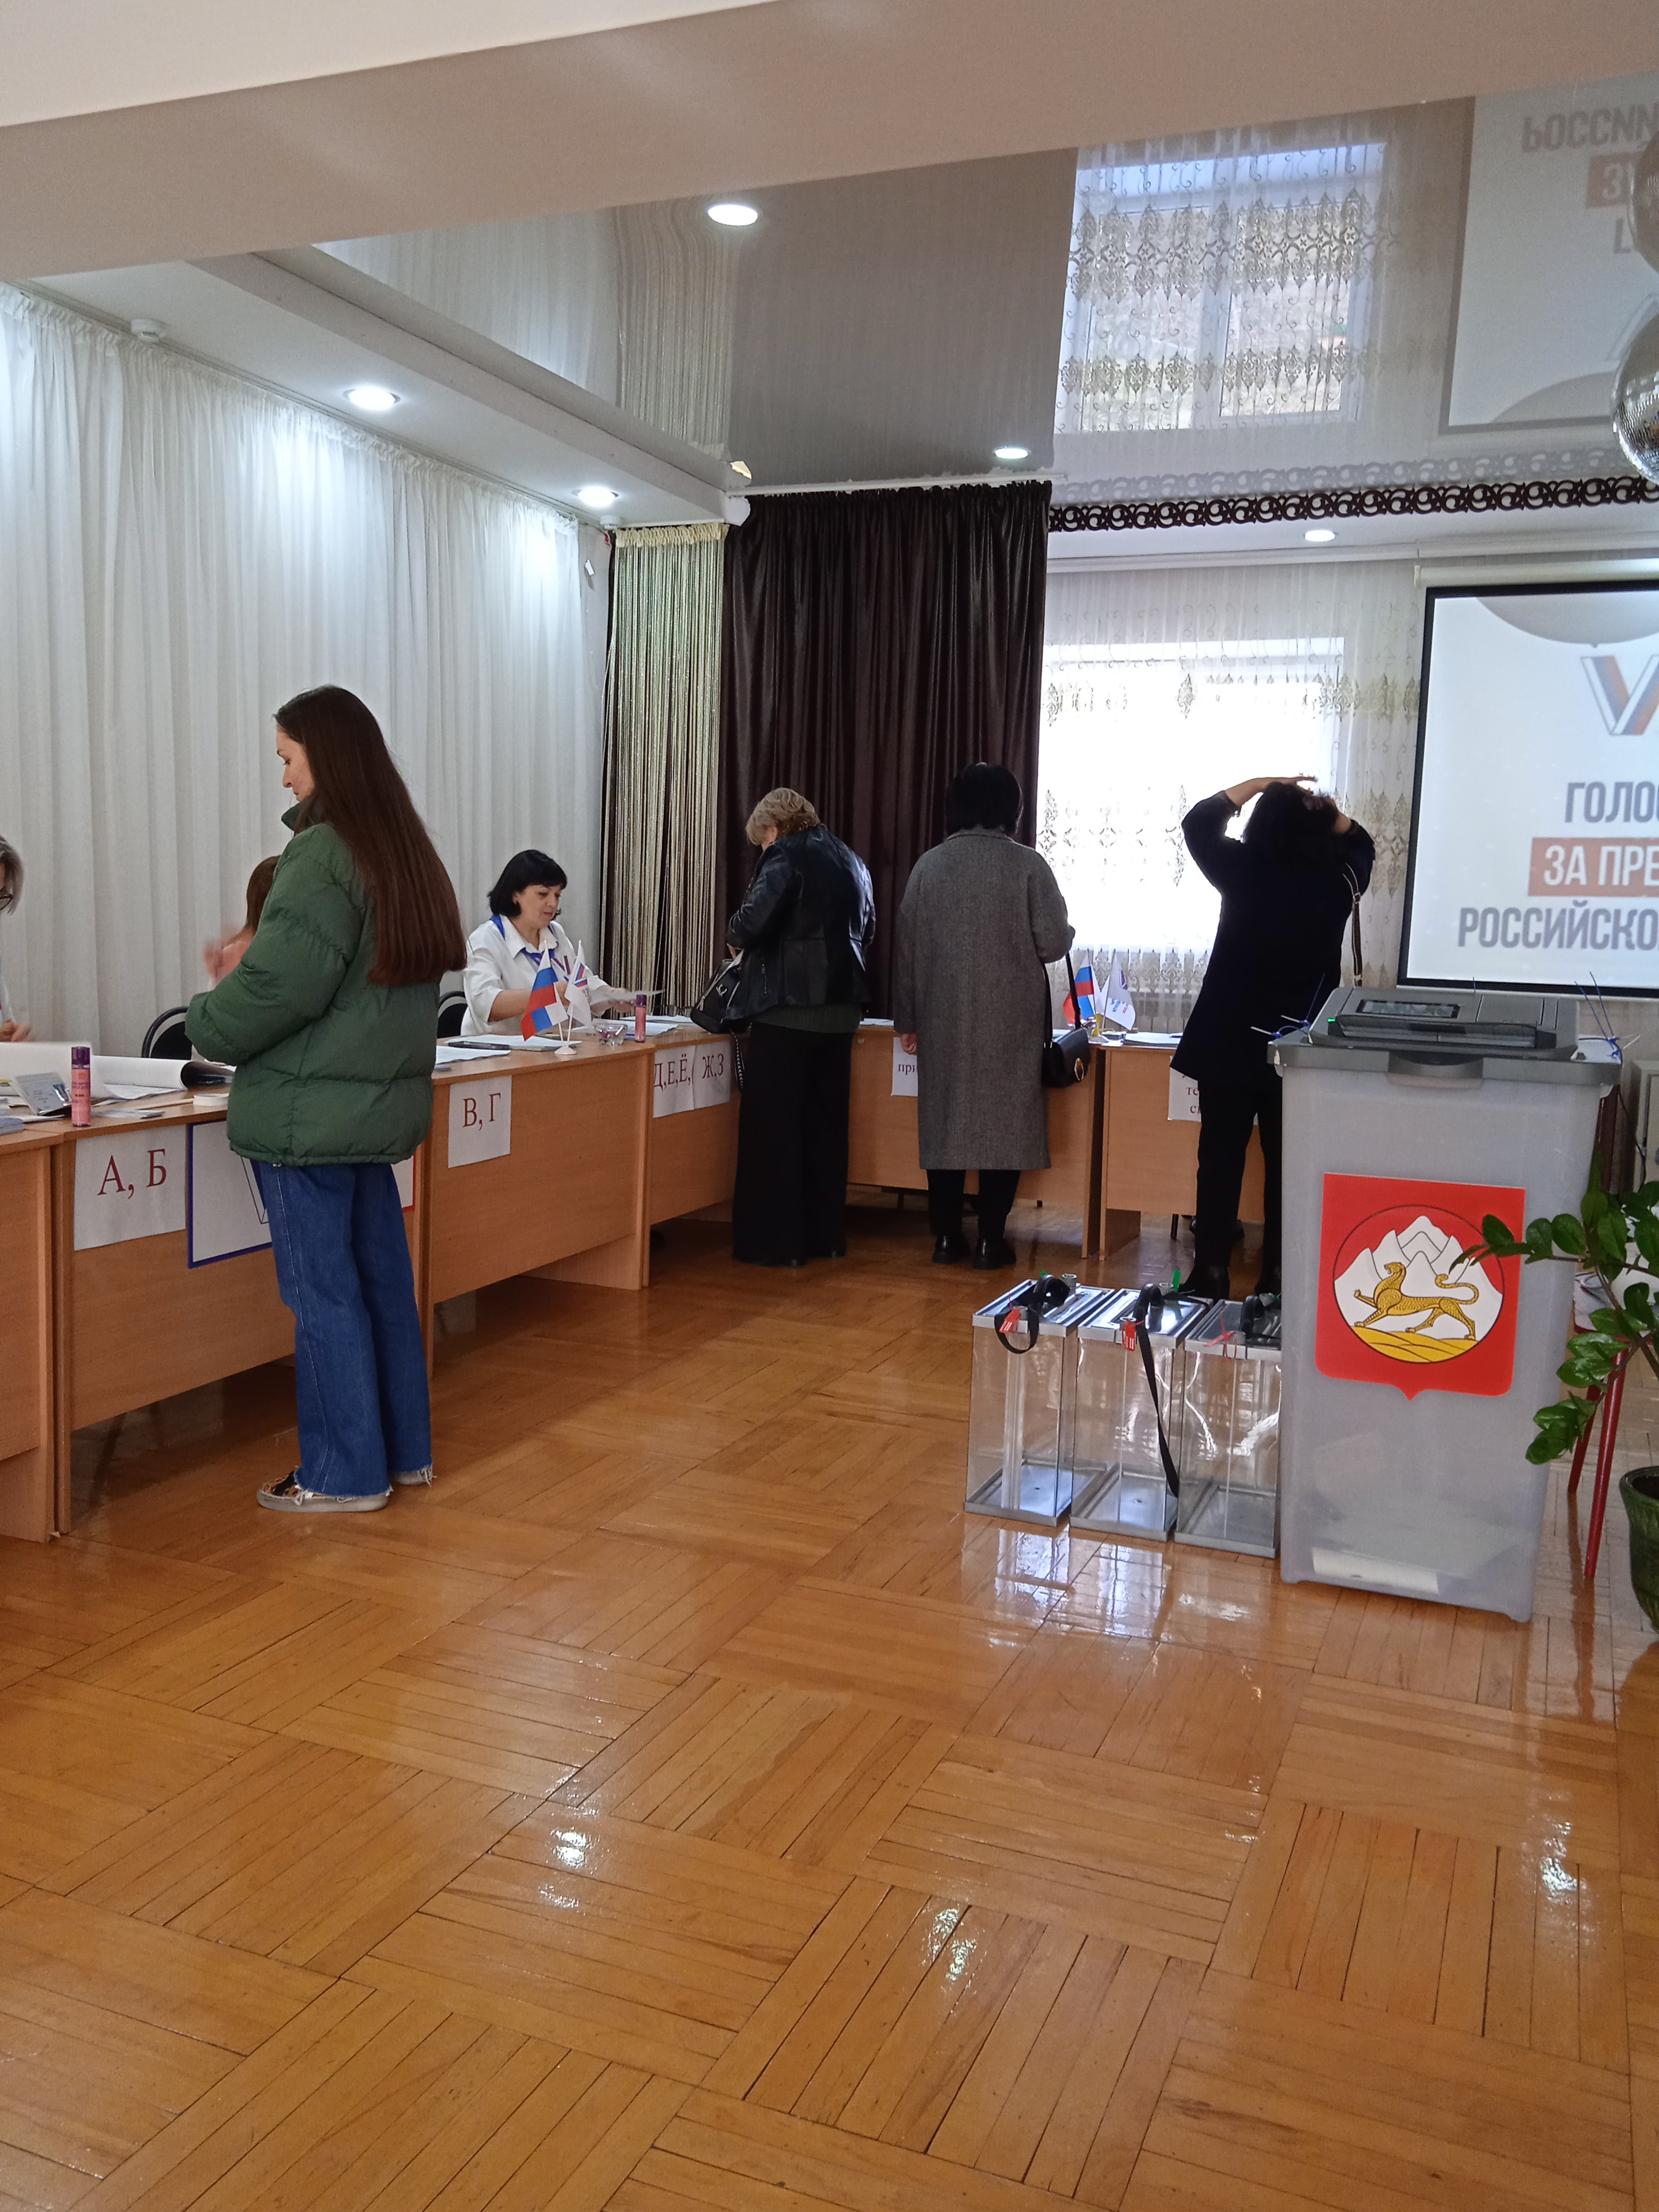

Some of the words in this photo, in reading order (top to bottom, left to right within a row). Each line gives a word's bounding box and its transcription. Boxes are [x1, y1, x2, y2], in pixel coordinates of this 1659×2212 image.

[1564, 781, 1659, 823] ГОЛО
[1544, 845, 1587, 886] ЗА
[1598, 845, 1659, 886] ПРЕ
[1457, 899, 1659, 951] РОССИЙСКО
[489, 1093, 501, 1122] Г
[97, 1155, 135, 1199] А,
[146, 1149, 166, 1187] Б
